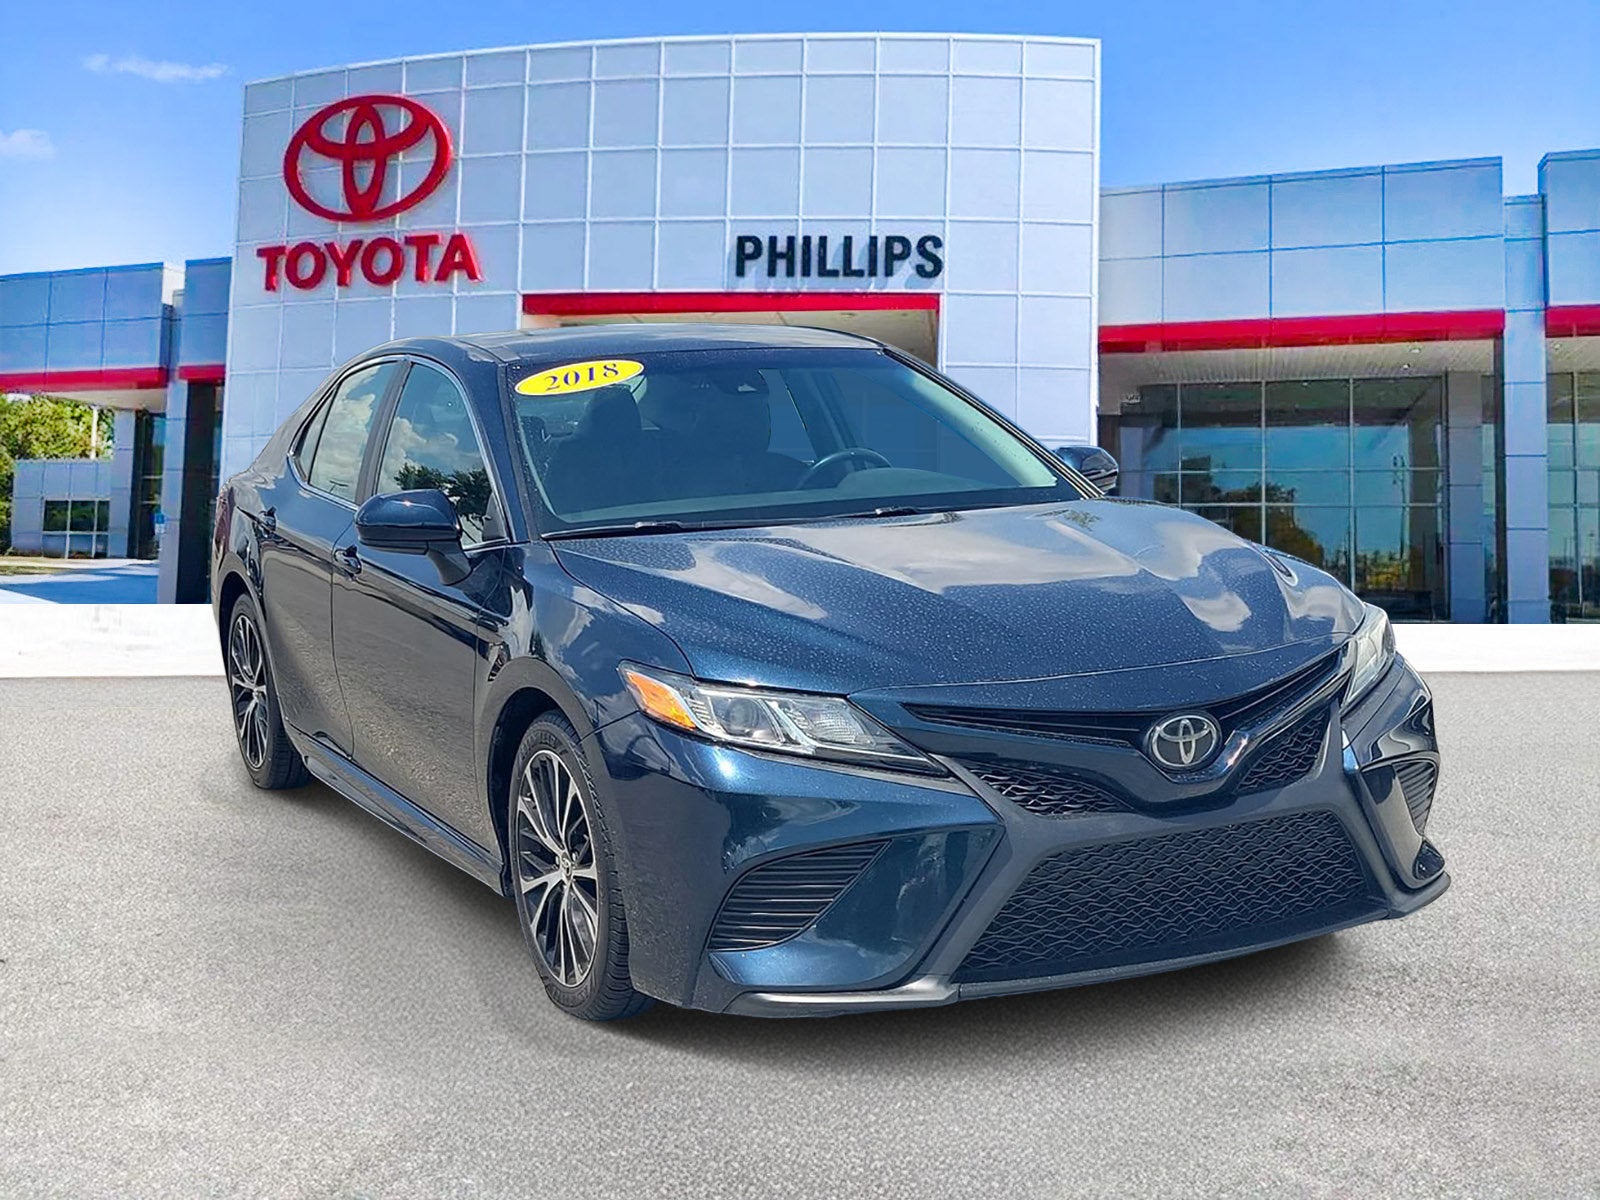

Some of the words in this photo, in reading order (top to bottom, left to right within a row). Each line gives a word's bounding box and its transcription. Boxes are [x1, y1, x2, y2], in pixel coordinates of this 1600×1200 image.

[257, 233, 482, 292] TOYOTA
[735, 235, 943, 278] PHILLIPS
[544, 363, 619, 391] 2018
